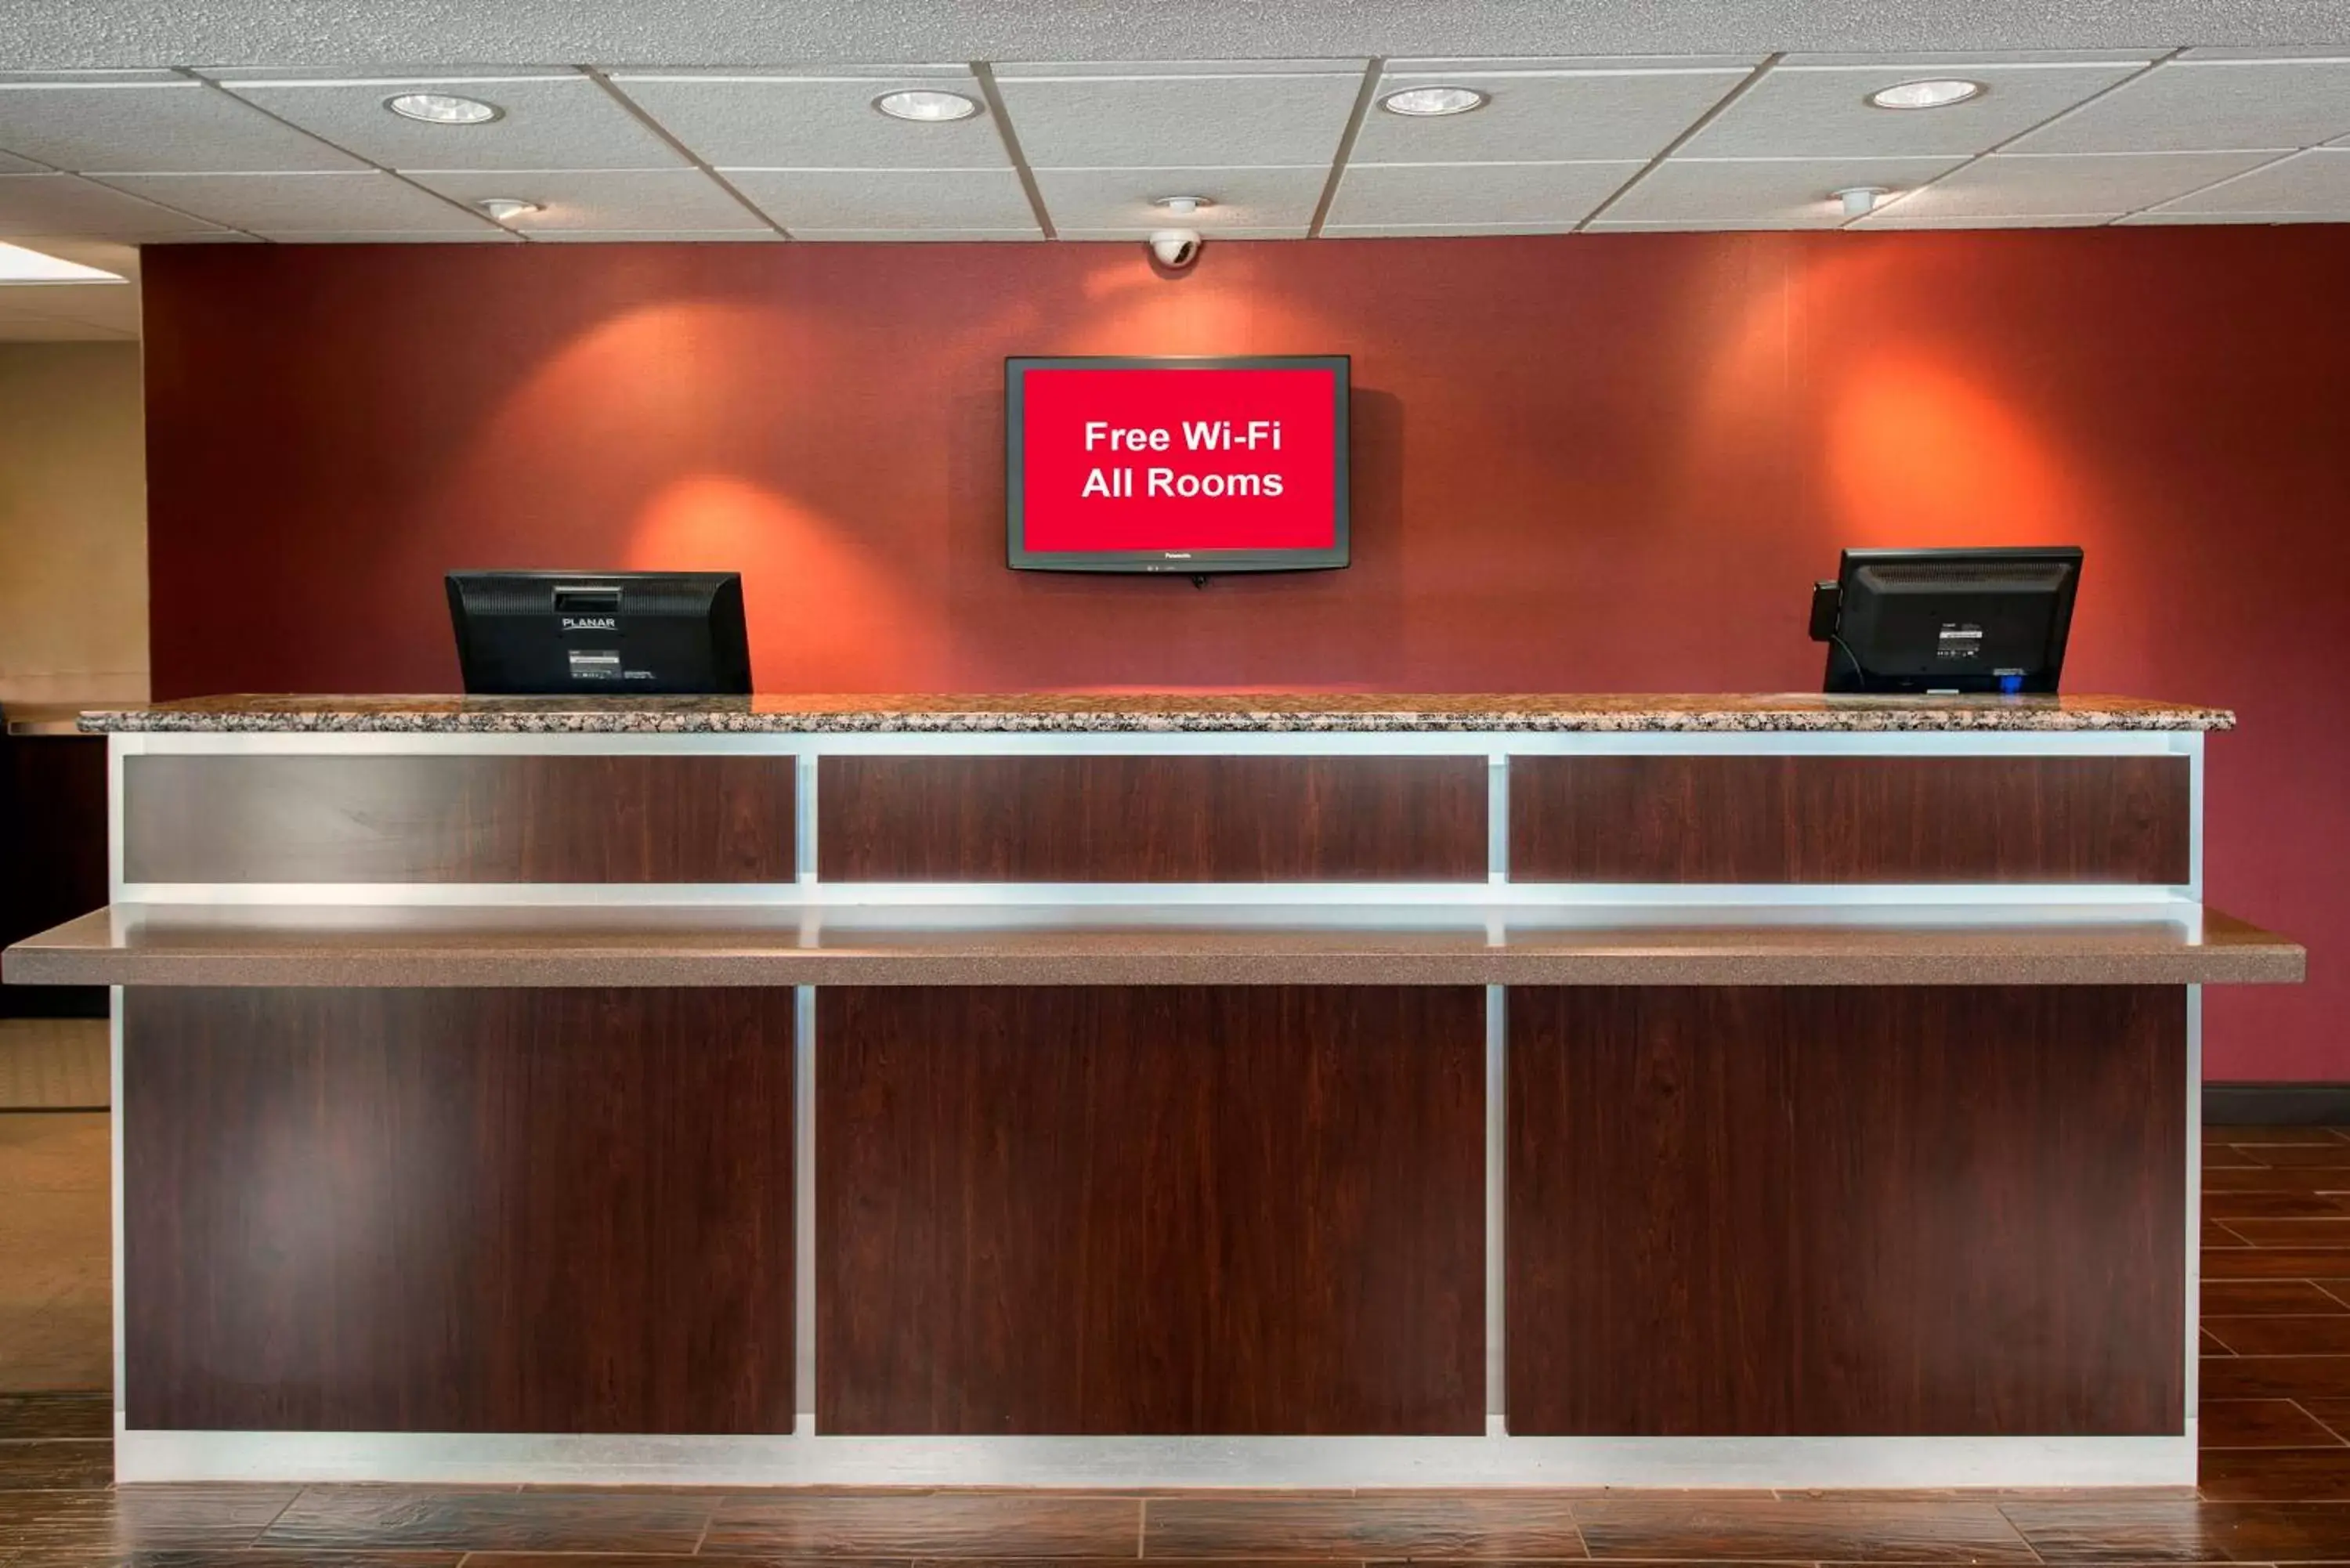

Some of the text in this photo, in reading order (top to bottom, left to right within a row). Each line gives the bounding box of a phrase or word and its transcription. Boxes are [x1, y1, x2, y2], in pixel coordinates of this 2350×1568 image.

[1085, 421, 1281, 451] Free Wi-Fi
[1081, 468, 1284, 497] All Rooms
[562, 618, 616, 627] PLANAR
